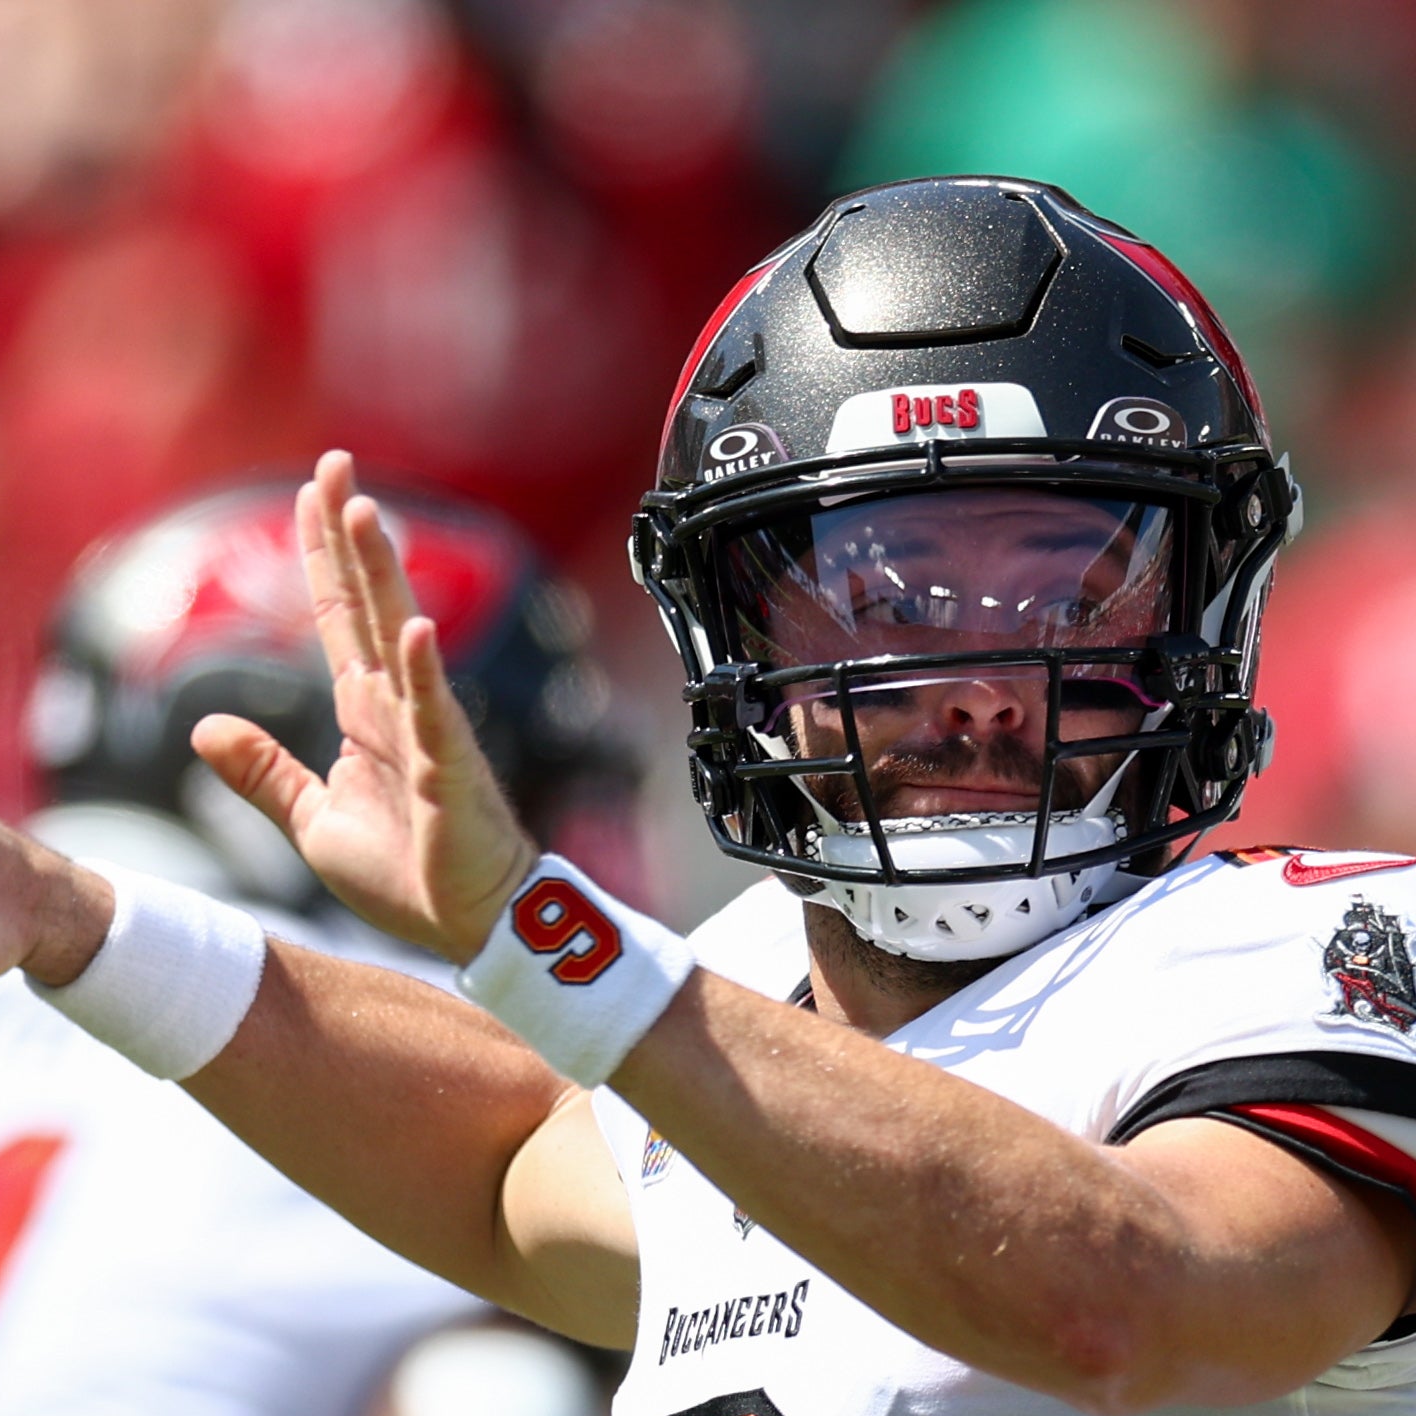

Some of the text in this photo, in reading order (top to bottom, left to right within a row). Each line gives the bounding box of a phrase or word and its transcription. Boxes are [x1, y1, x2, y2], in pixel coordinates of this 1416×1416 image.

[891, 388, 980, 434] BUCS
[704, 450, 773, 483] OAKLEY
[658, 1278, 811, 1367] BUCCANEERS
